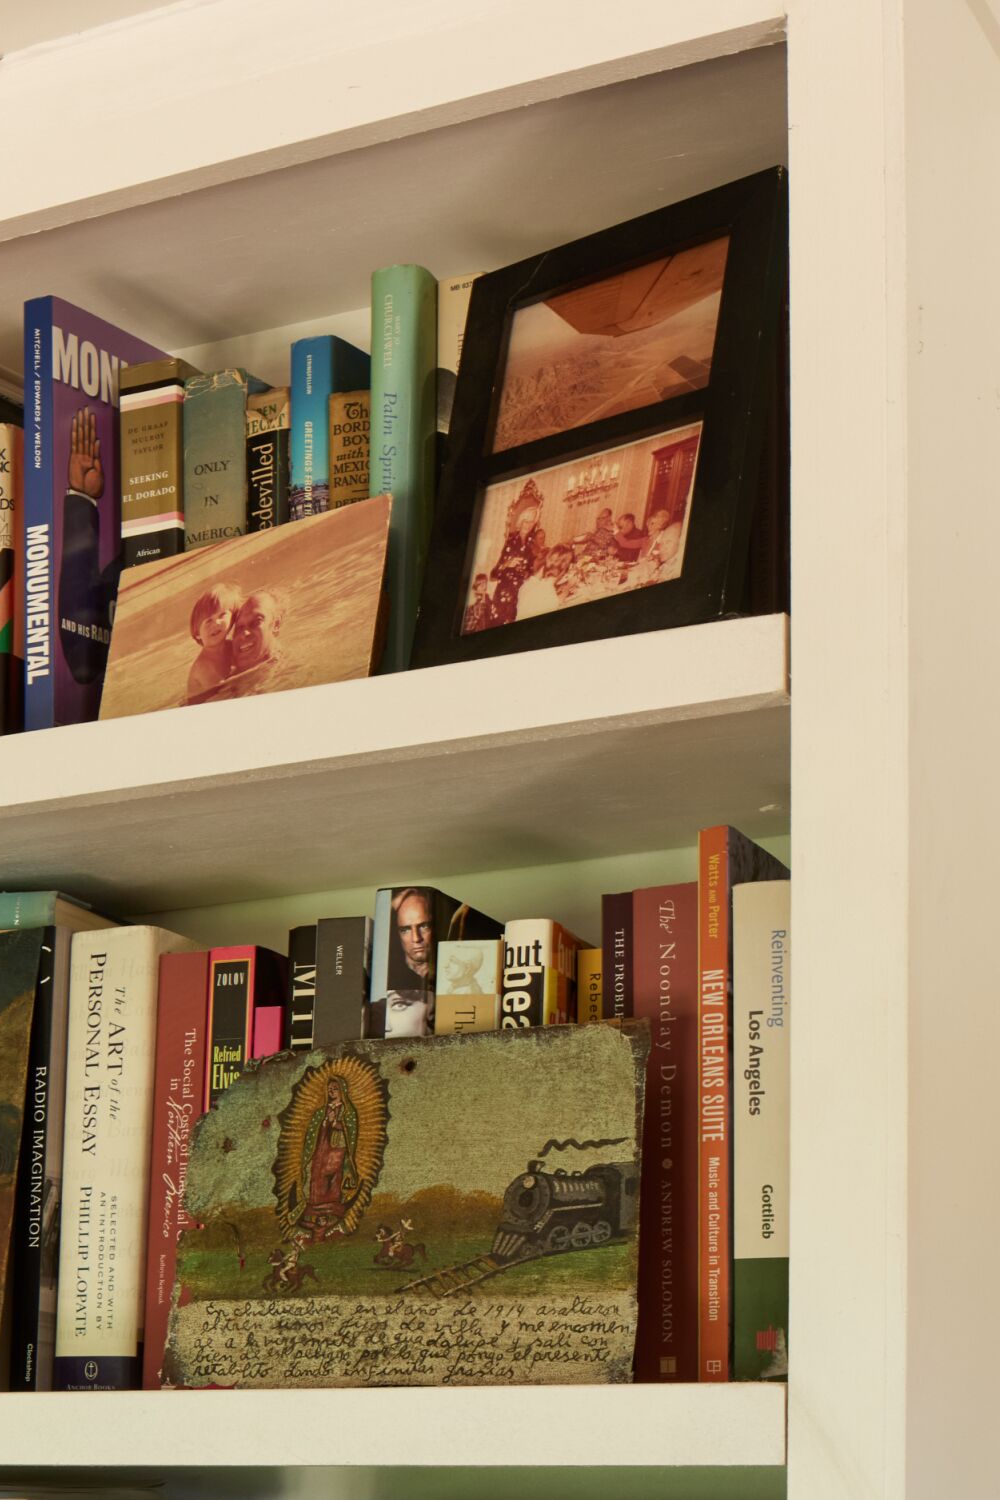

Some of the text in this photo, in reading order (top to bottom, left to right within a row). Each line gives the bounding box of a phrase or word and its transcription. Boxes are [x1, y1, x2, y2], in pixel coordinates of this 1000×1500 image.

[33, 328, 41, 370] MITCHELL
[194, 459, 231, 476] ONLY
[305, 421, 313, 470] GREETINGS
[129, 471, 169, 486] SEEKING
[136, 486, 176, 501] DORADO
[204, 495, 219, 506] IN
[136, 547, 160, 558] African
[185, 526, 243, 544] AMERICA
[25, 523, 50, 685] MONUMENTAL
[708, 854, 721, 939] Watts Porter
[335, 944, 343, 976] WELLER
[504, 939, 542, 967] but
[216, 972, 245, 987] ZOLOV
[656, 943, 676, 1051] Noonday
[767, 929, 786, 1028] Reinventing
[81, 952, 107, 1156] PERSONAL ESSAY
[107, 1022, 125, 1076] ART
[213, 1045, 241, 1063] Refried
[701, 969, 725, 1142] NEW ORLEANS SUITE
[744, 1010, 765, 1116] Los Angeles
[28, 1066, 47, 1248] RADIO IMAGINATION
[761, 1184, 774, 1240] Gottlieb
[75, 1186, 92, 1337] PHILLIP LOPATE
[25, 1343, 34, 1382] Clockshop
